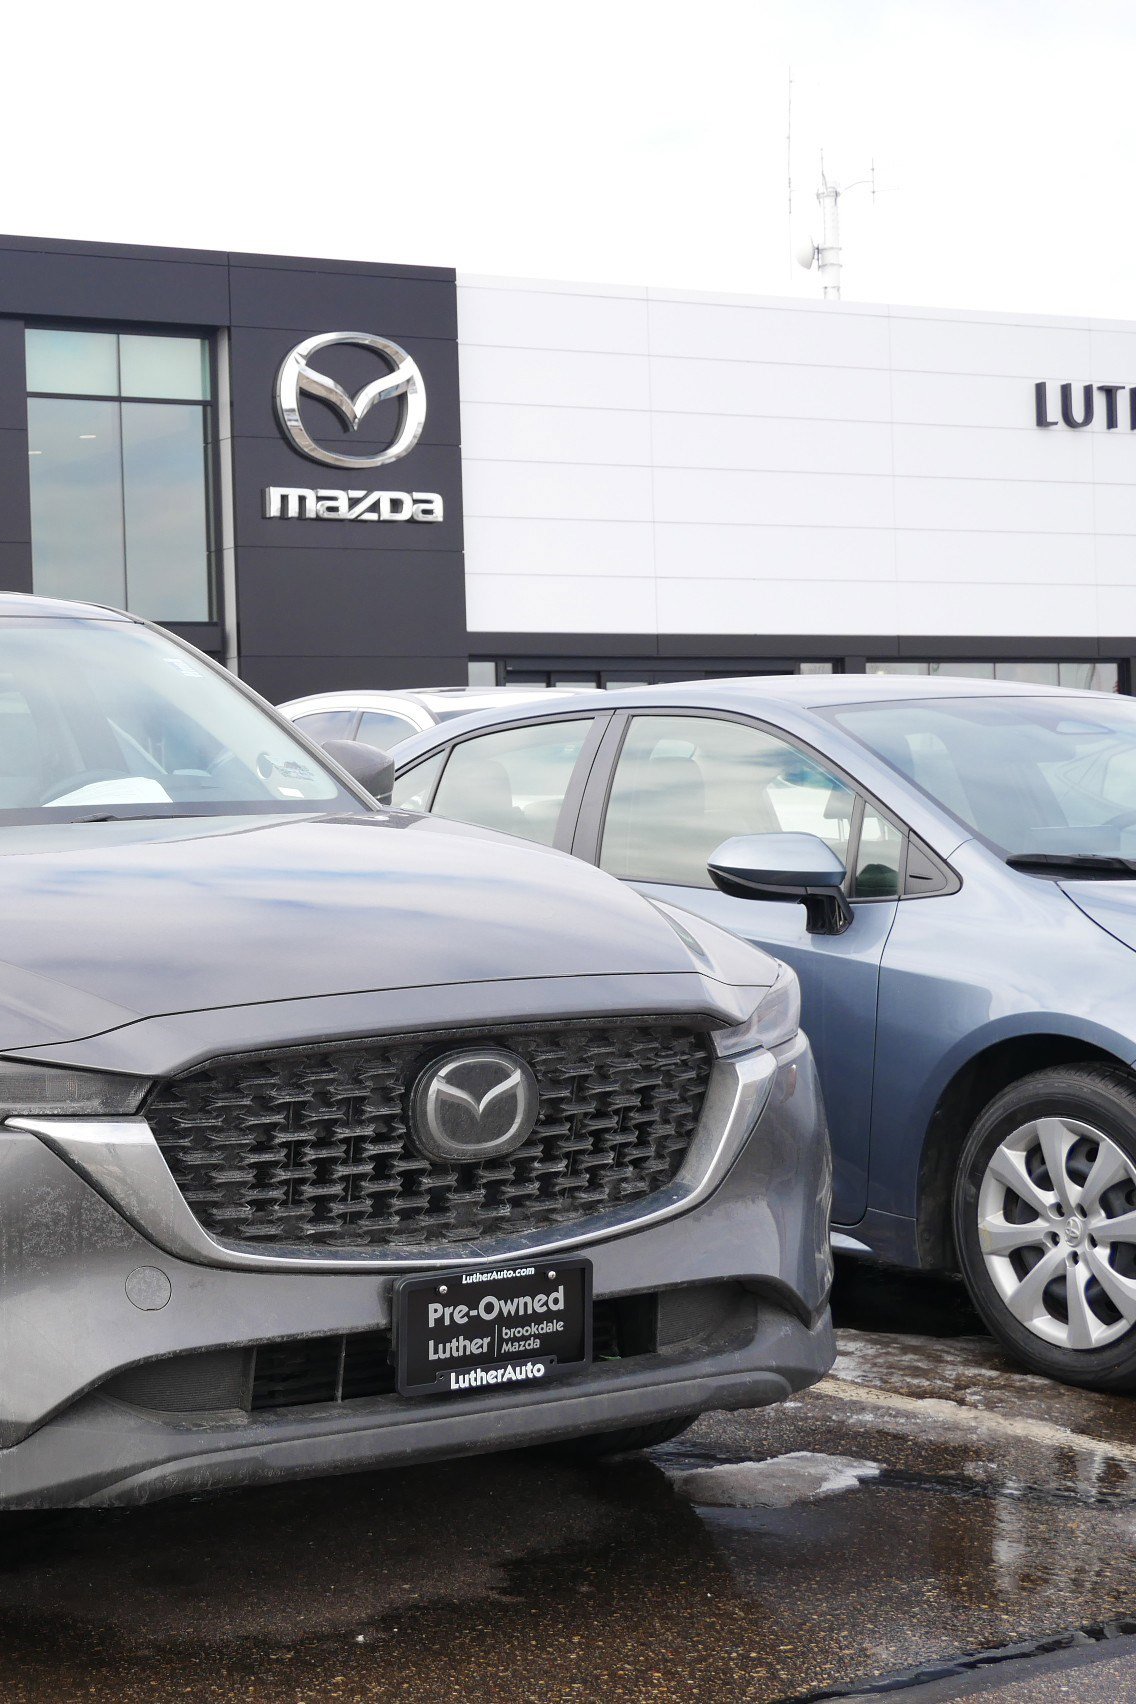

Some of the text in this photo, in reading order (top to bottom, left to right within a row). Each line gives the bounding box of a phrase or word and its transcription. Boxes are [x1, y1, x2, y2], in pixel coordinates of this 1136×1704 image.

[462, 1266, 535, 1284] LutherAuto.com
[428, 1285, 565, 1328] Pre-Owned
[502, 1319, 565, 1339] brookdale
[428, 1335, 491, 1361] Luther
[501, 1337, 541, 1354] Mazda
[450, 1362, 545, 1390] LutherAuto
